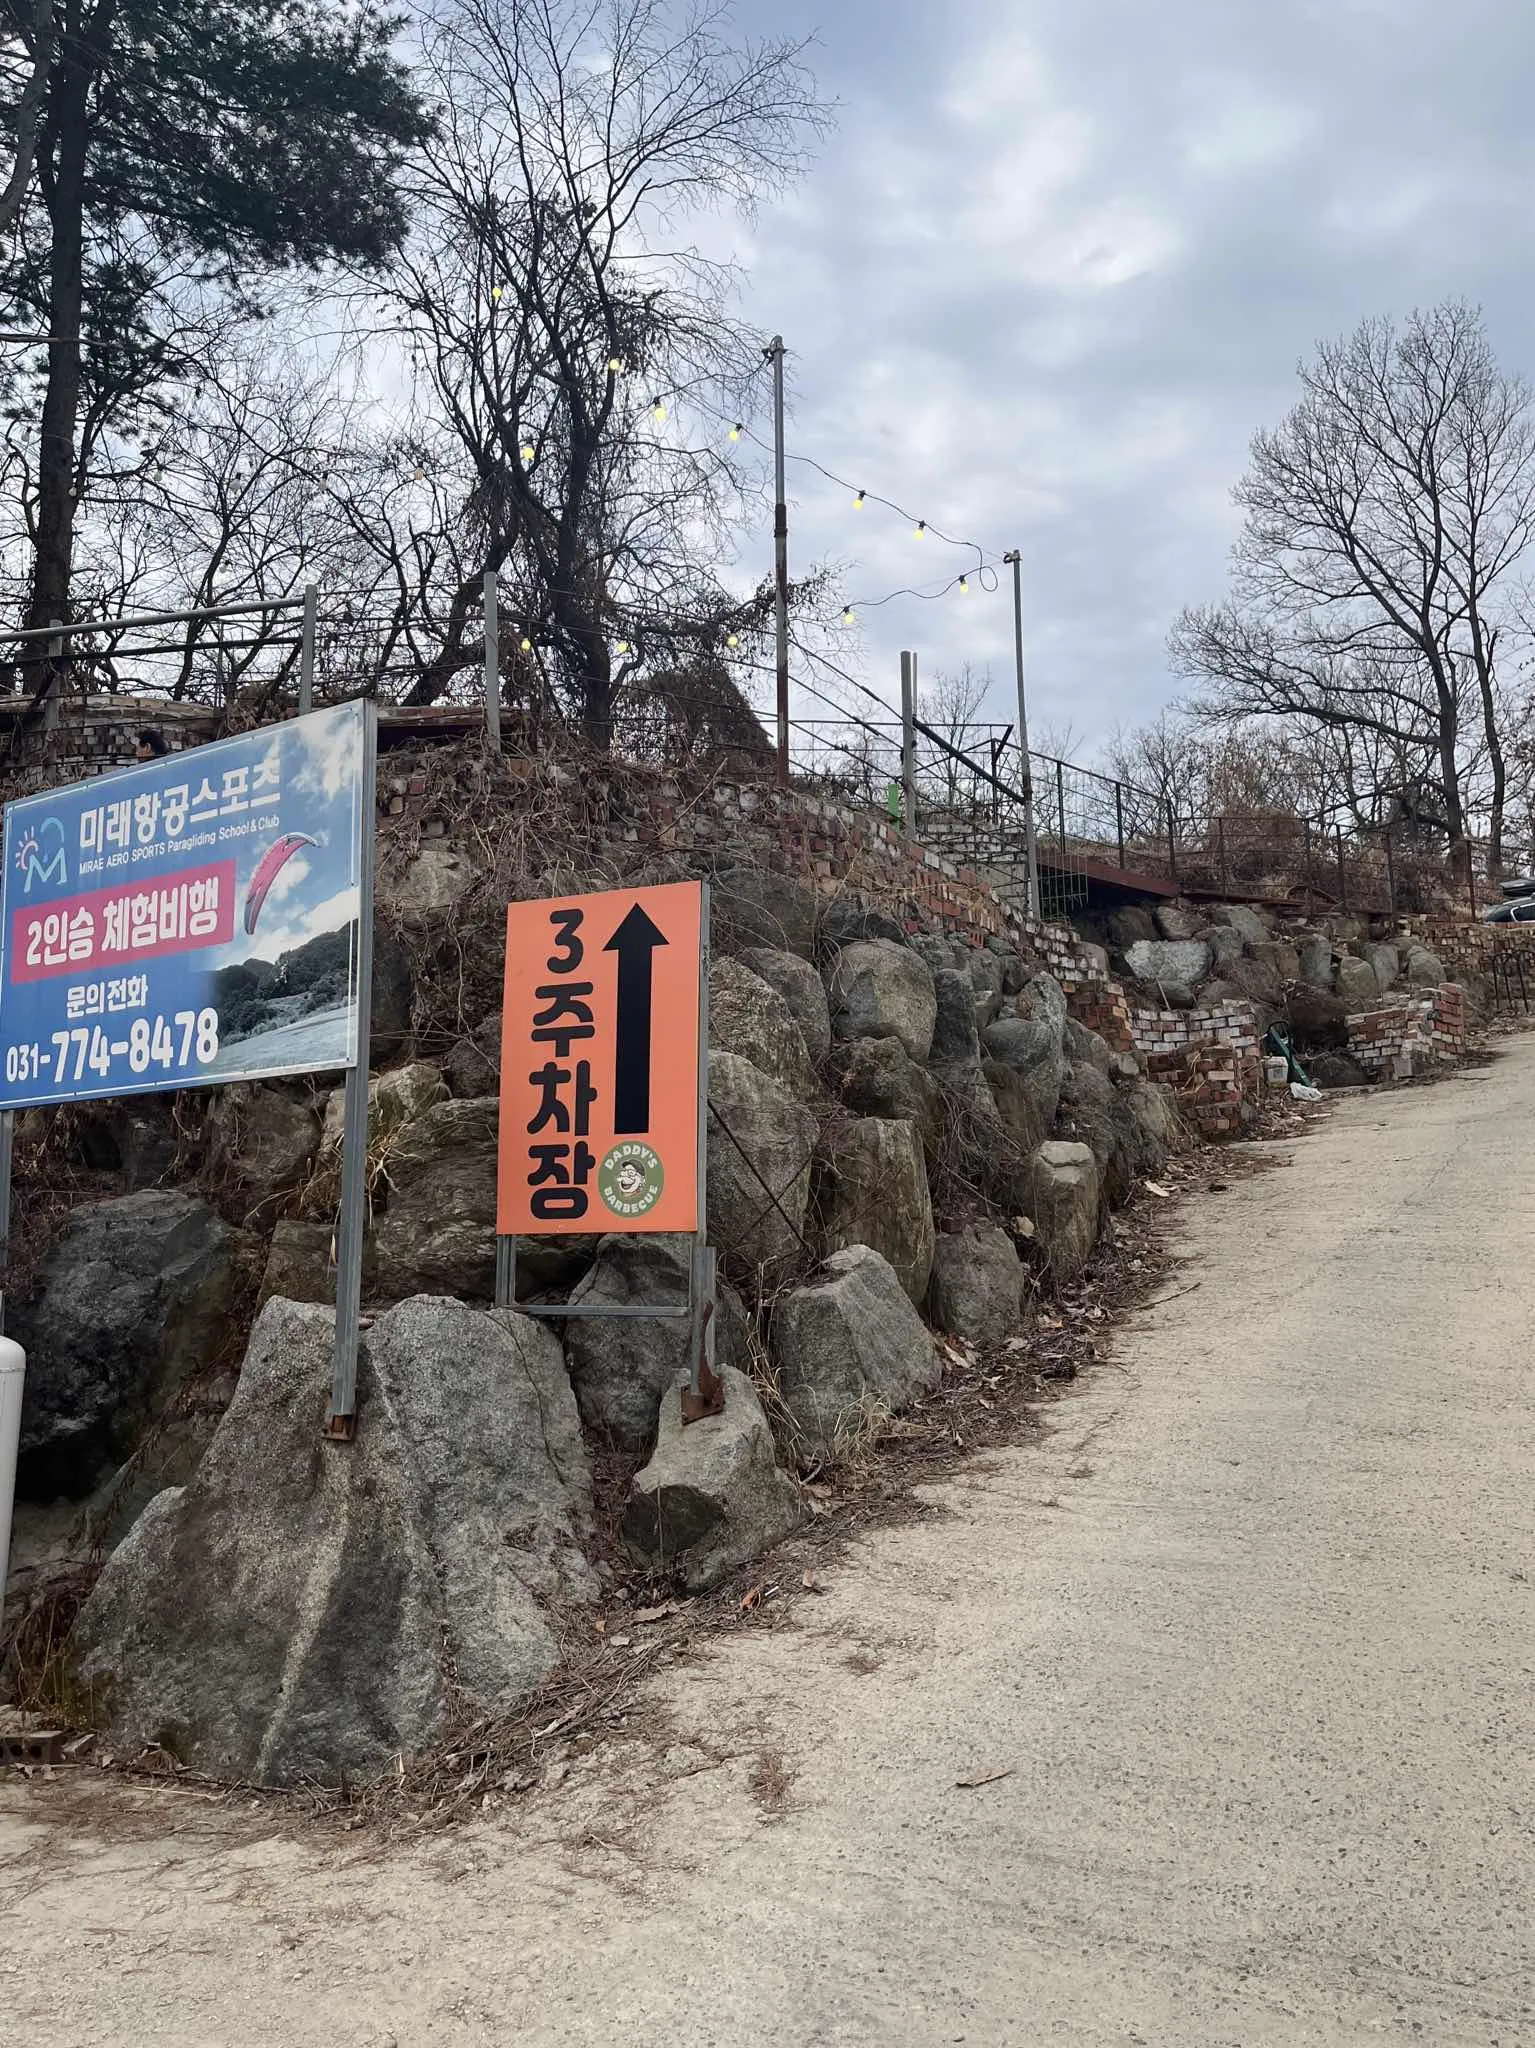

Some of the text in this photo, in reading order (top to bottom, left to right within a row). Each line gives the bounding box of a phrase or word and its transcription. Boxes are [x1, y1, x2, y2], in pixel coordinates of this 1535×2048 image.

[80, 754, 281, 853] 미래항공스포츠
[79, 858, 104, 875] MIRAE
[106, 852, 130, 869] AERO
[131, 844, 165, 862] SPORTS
[168, 832, 216, 851] Paragliding
[26, 876, 219, 966] 2인승 체험비행
[6, 1007, 219, 1083] 031-774-8478
[604, 1144, 658, 1170] DADDY'S
[604, 1184, 658, 1213] BARBECUE
